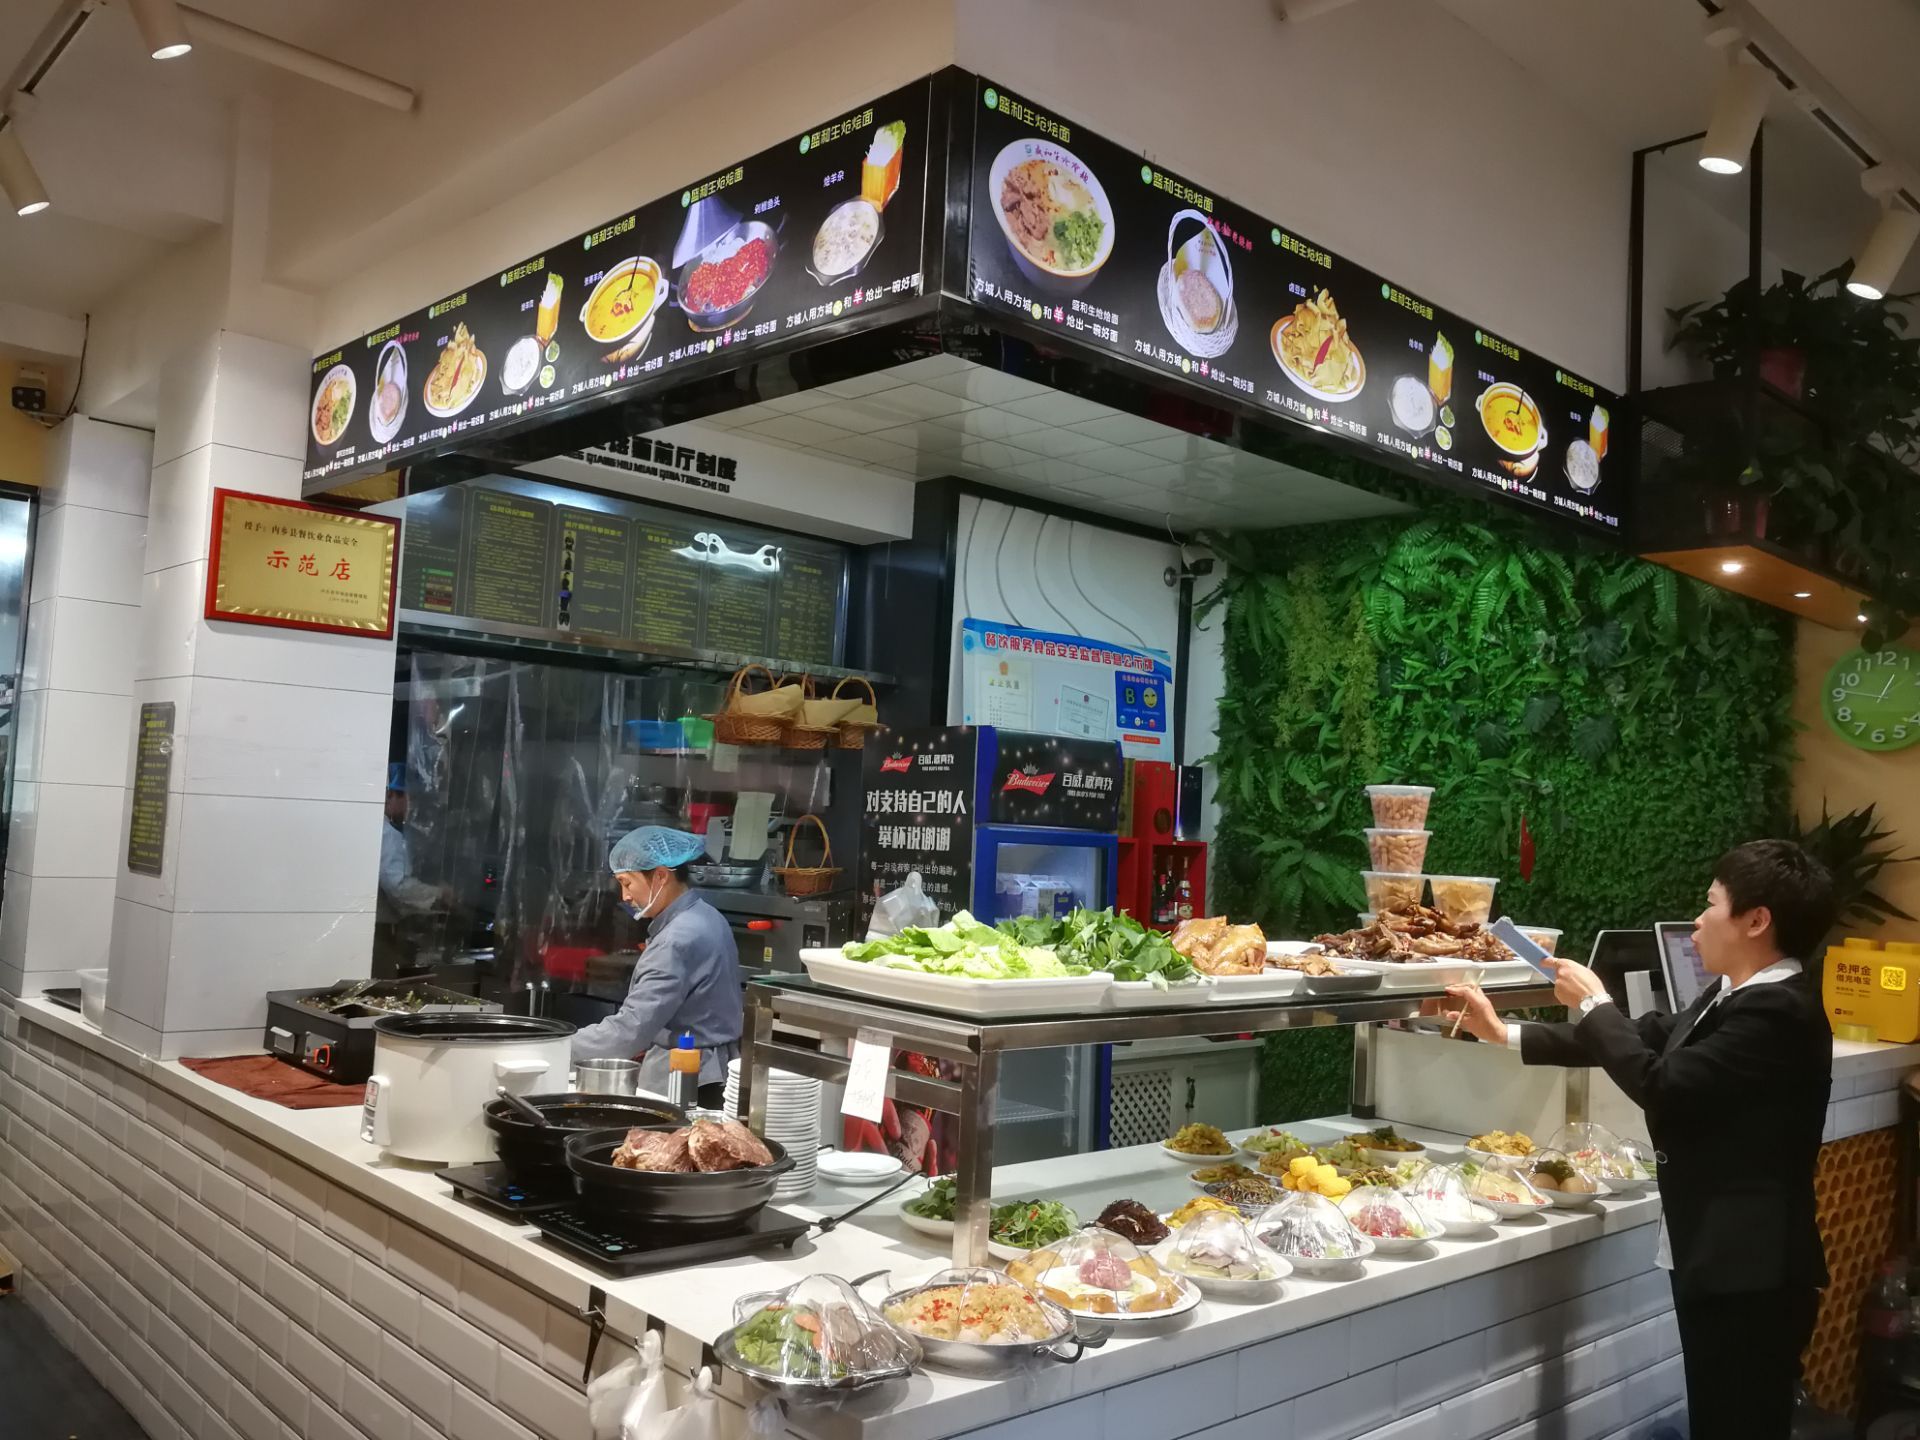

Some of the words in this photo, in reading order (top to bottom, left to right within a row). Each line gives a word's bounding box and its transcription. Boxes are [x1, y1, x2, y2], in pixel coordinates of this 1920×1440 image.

[266, 550, 352, 581] 示范店
[984, 632, 1155, 673] 餐饮服务食品安全监督信息公示牌
[1875, 651, 1897, 666] 12
[1855, 658, 1872, 672] 11
[1902, 657, 1910, 671] 1
[1839, 672, 1860, 687] 10
[1124, 687, 1136, 705] B
[1832, 688, 1846, 702] 9
[1837, 707, 1852, 722] 8
[1853, 721, 1867, 736] 7
[1871, 729, 1886, 743] 6
[1892, 724, 1907, 739] 5
[1007, 773, 1050, 788] Budweiser
[866, 790, 967, 815] 对支持自己的人
[878, 825, 952, 852] 举杯说谢谢
[1836, 962, 1872, 976] 免押金
[1836, 974, 1871, 985] 借充电宝
